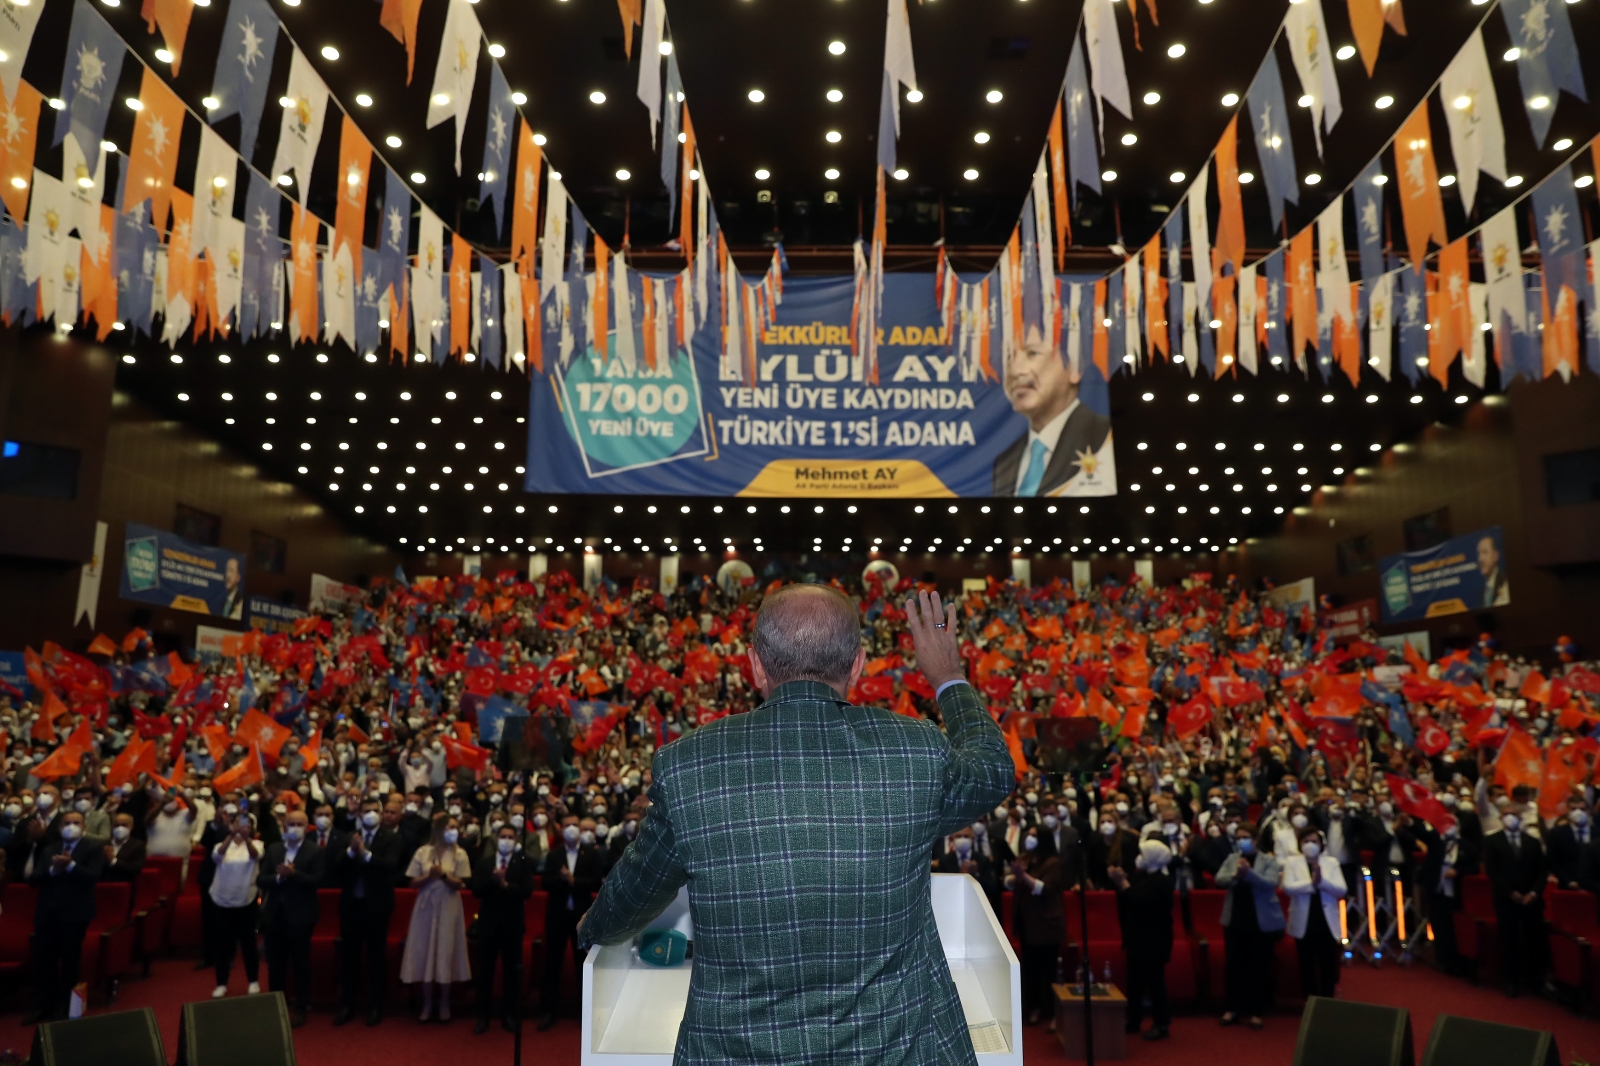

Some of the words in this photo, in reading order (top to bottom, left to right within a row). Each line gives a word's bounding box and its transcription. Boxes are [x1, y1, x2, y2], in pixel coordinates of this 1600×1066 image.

[720, 321, 885, 346] EKKÜRLR
[575, 382, 689, 415] 17000
[719, 382, 779, 409] YENİ
[785, 383, 837, 409] ÜYE
[843, 388, 975, 409] KAYDINDA
[588, 417, 632, 437] YENİ
[636, 417, 674, 437] ÜYE
[718, 415, 826, 446] TÜRKİYE
[884, 421, 976, 446] ADANA
[795, 466, 869, 481] Mehmet
[874, 467, 898, 481] AY
